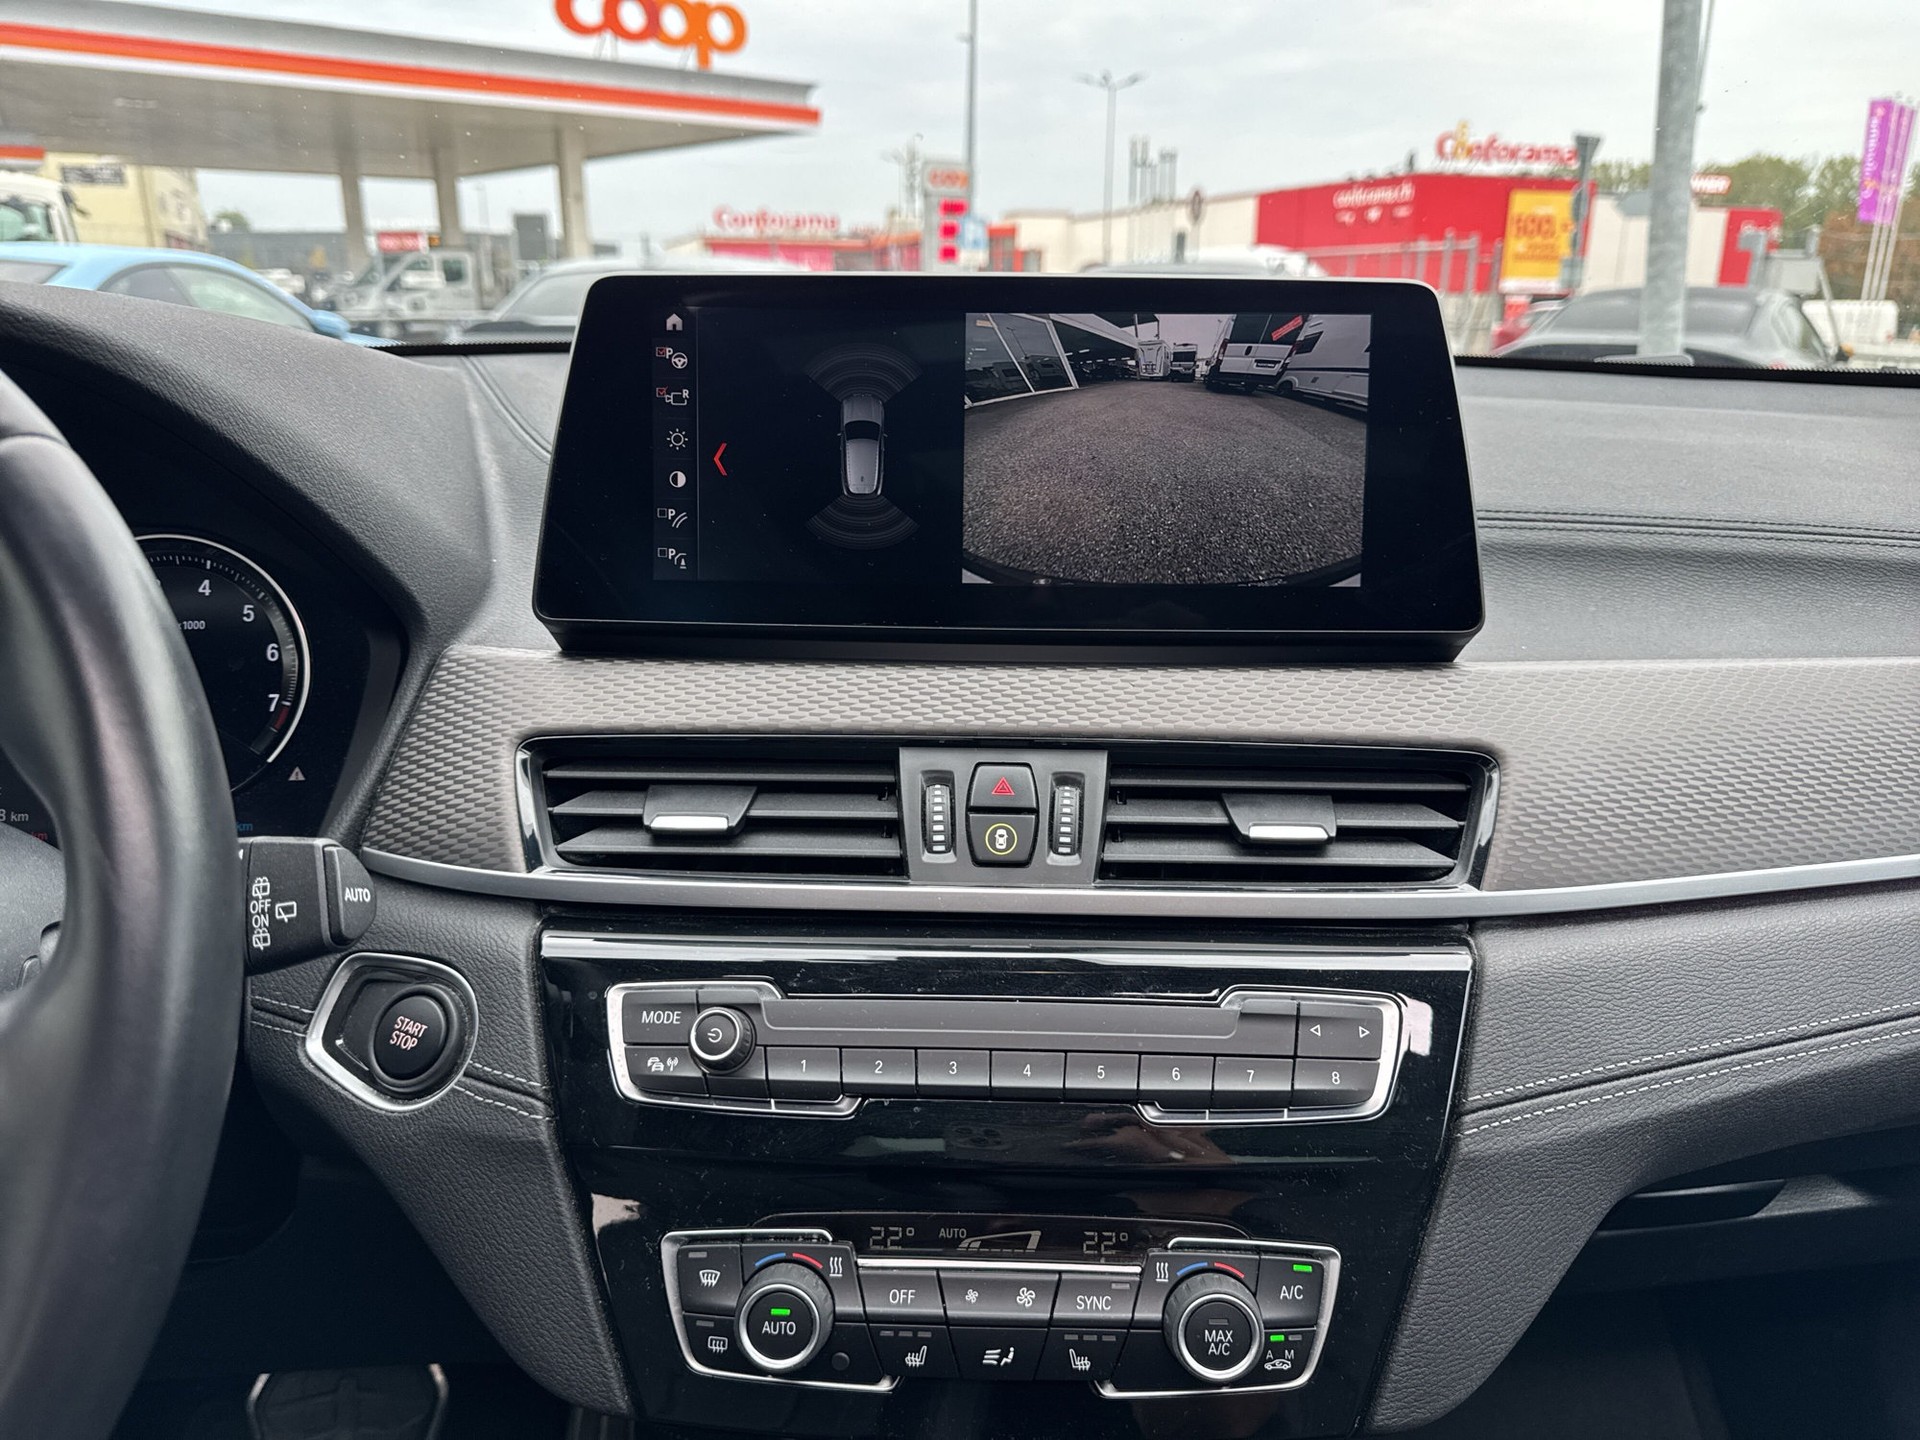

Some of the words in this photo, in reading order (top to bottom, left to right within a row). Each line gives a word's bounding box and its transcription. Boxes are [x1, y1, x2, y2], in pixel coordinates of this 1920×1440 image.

[554, 0, 747, 70] coop
[198, 579, 212, 596] 4
[242, 604, 255, 622] 5
[266, 643, 279, 662] 6
[268, 693, 280, 712] 7
[10, 811, 29, 822] km
[344, 888, 371, 902] AUTO
[250, 899, 272, 914] OFF
[252, 914, 269, 928] ON
[641, 1010, 681, 1025] MODE
[394, 1015, 427, 1039] START
[390, 1030, 418, 1051] STOP
[800, 1060, 807, 1073] 1
[875, 1060, 883, 1074] 2
[949, 1062, 958, 1076] 3
[1023, 1063, 1032, 1078] 4
[1097, 1065, 1106, 1080] 5
[1172, 1067, 1181, 1082] 6
[1246, 1070, 1255, 1084] 7
[1332, 1071, 1341, 1086] 8
[938, 1227, 967, 1239] AUTO
[889, 1289, 916, 1304] OFF
[1279, 1285, 1304, 1300] A/C
[1076, 1295, 1112, 1311] SYNC
[761, 1321, 797, 1335] AUTO
[1204, 1329, 1233, 1343] MAX
[1208, 1343, 1230, 1356] A/C
[1266, 1350, 1274, 1360] A
[1284, 1349, 1295, 1360] M
